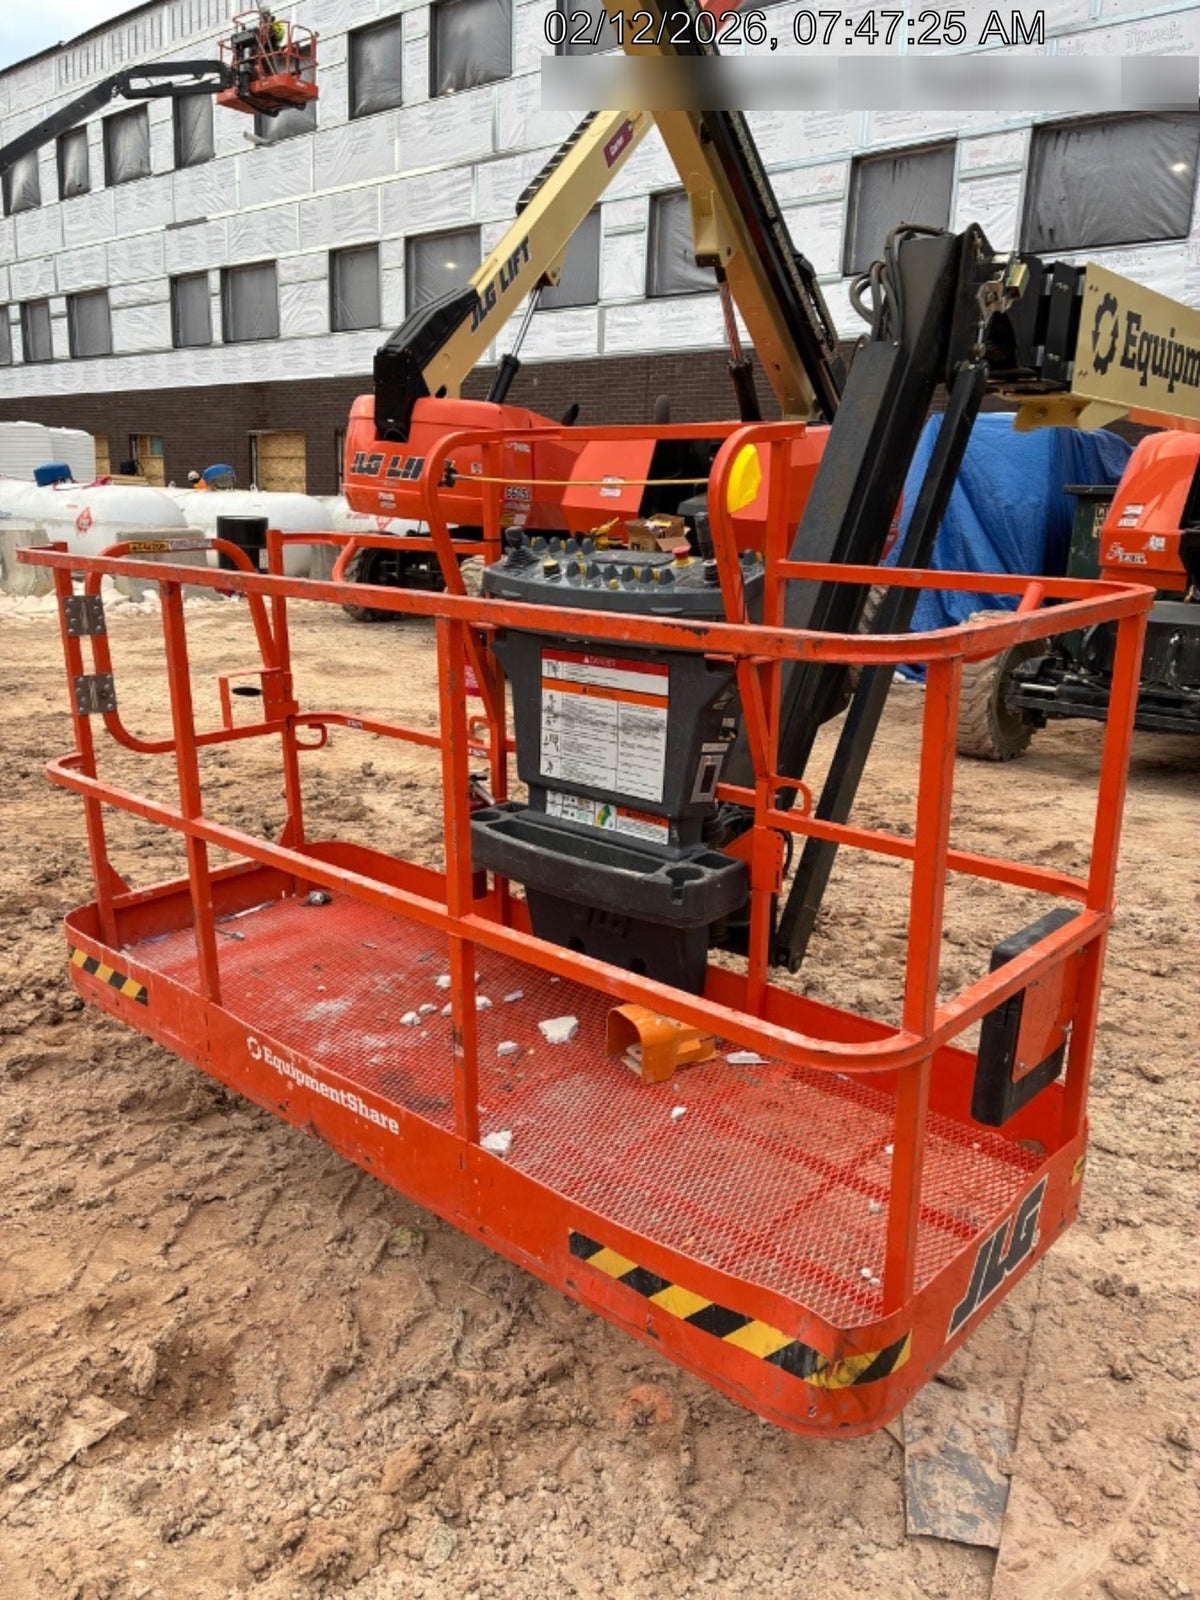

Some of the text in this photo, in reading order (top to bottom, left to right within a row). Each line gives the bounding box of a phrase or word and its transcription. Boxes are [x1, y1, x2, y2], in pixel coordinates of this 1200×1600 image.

[471, 235, 529, 333] JLG LIFT
[350, 451, 386, 478] JLG
[262, 1046, 400, 1136] EquipmentShare
[946, 1174, 1048, 1343] JLG
